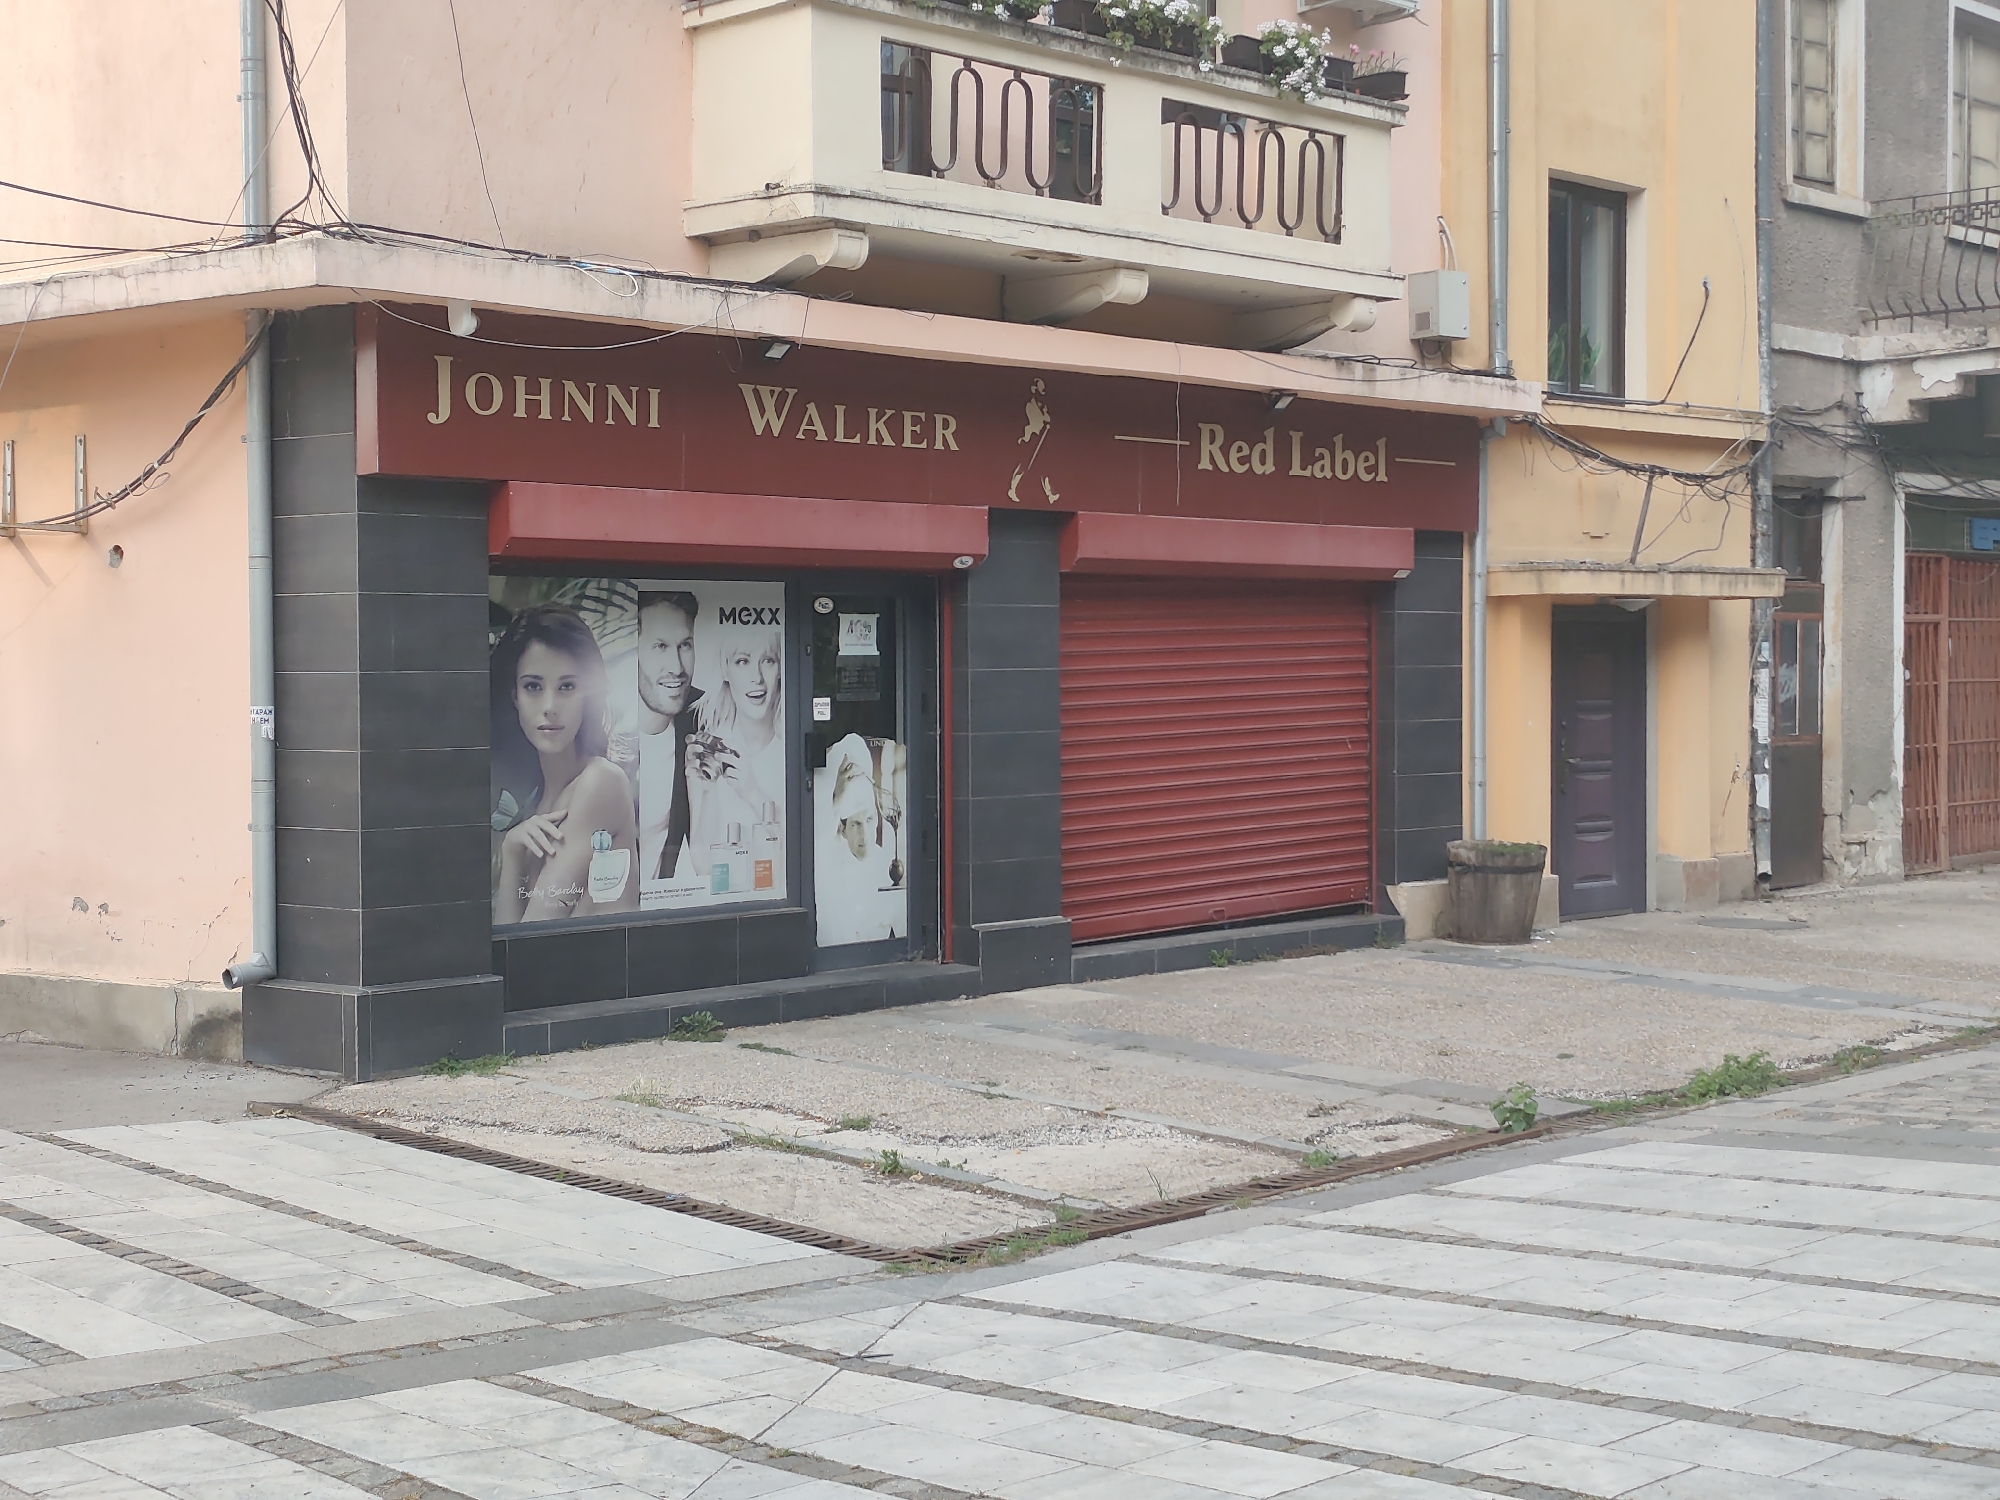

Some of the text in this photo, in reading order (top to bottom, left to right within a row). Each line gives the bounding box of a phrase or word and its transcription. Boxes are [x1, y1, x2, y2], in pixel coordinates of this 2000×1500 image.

[427, 354, 960, 452] JOHNNI WALKER
[1197, 422, 1388, 483] Red Label
[251, 717, 270, 725] НЕМ
[547, 882, 585, 899] Barclay
